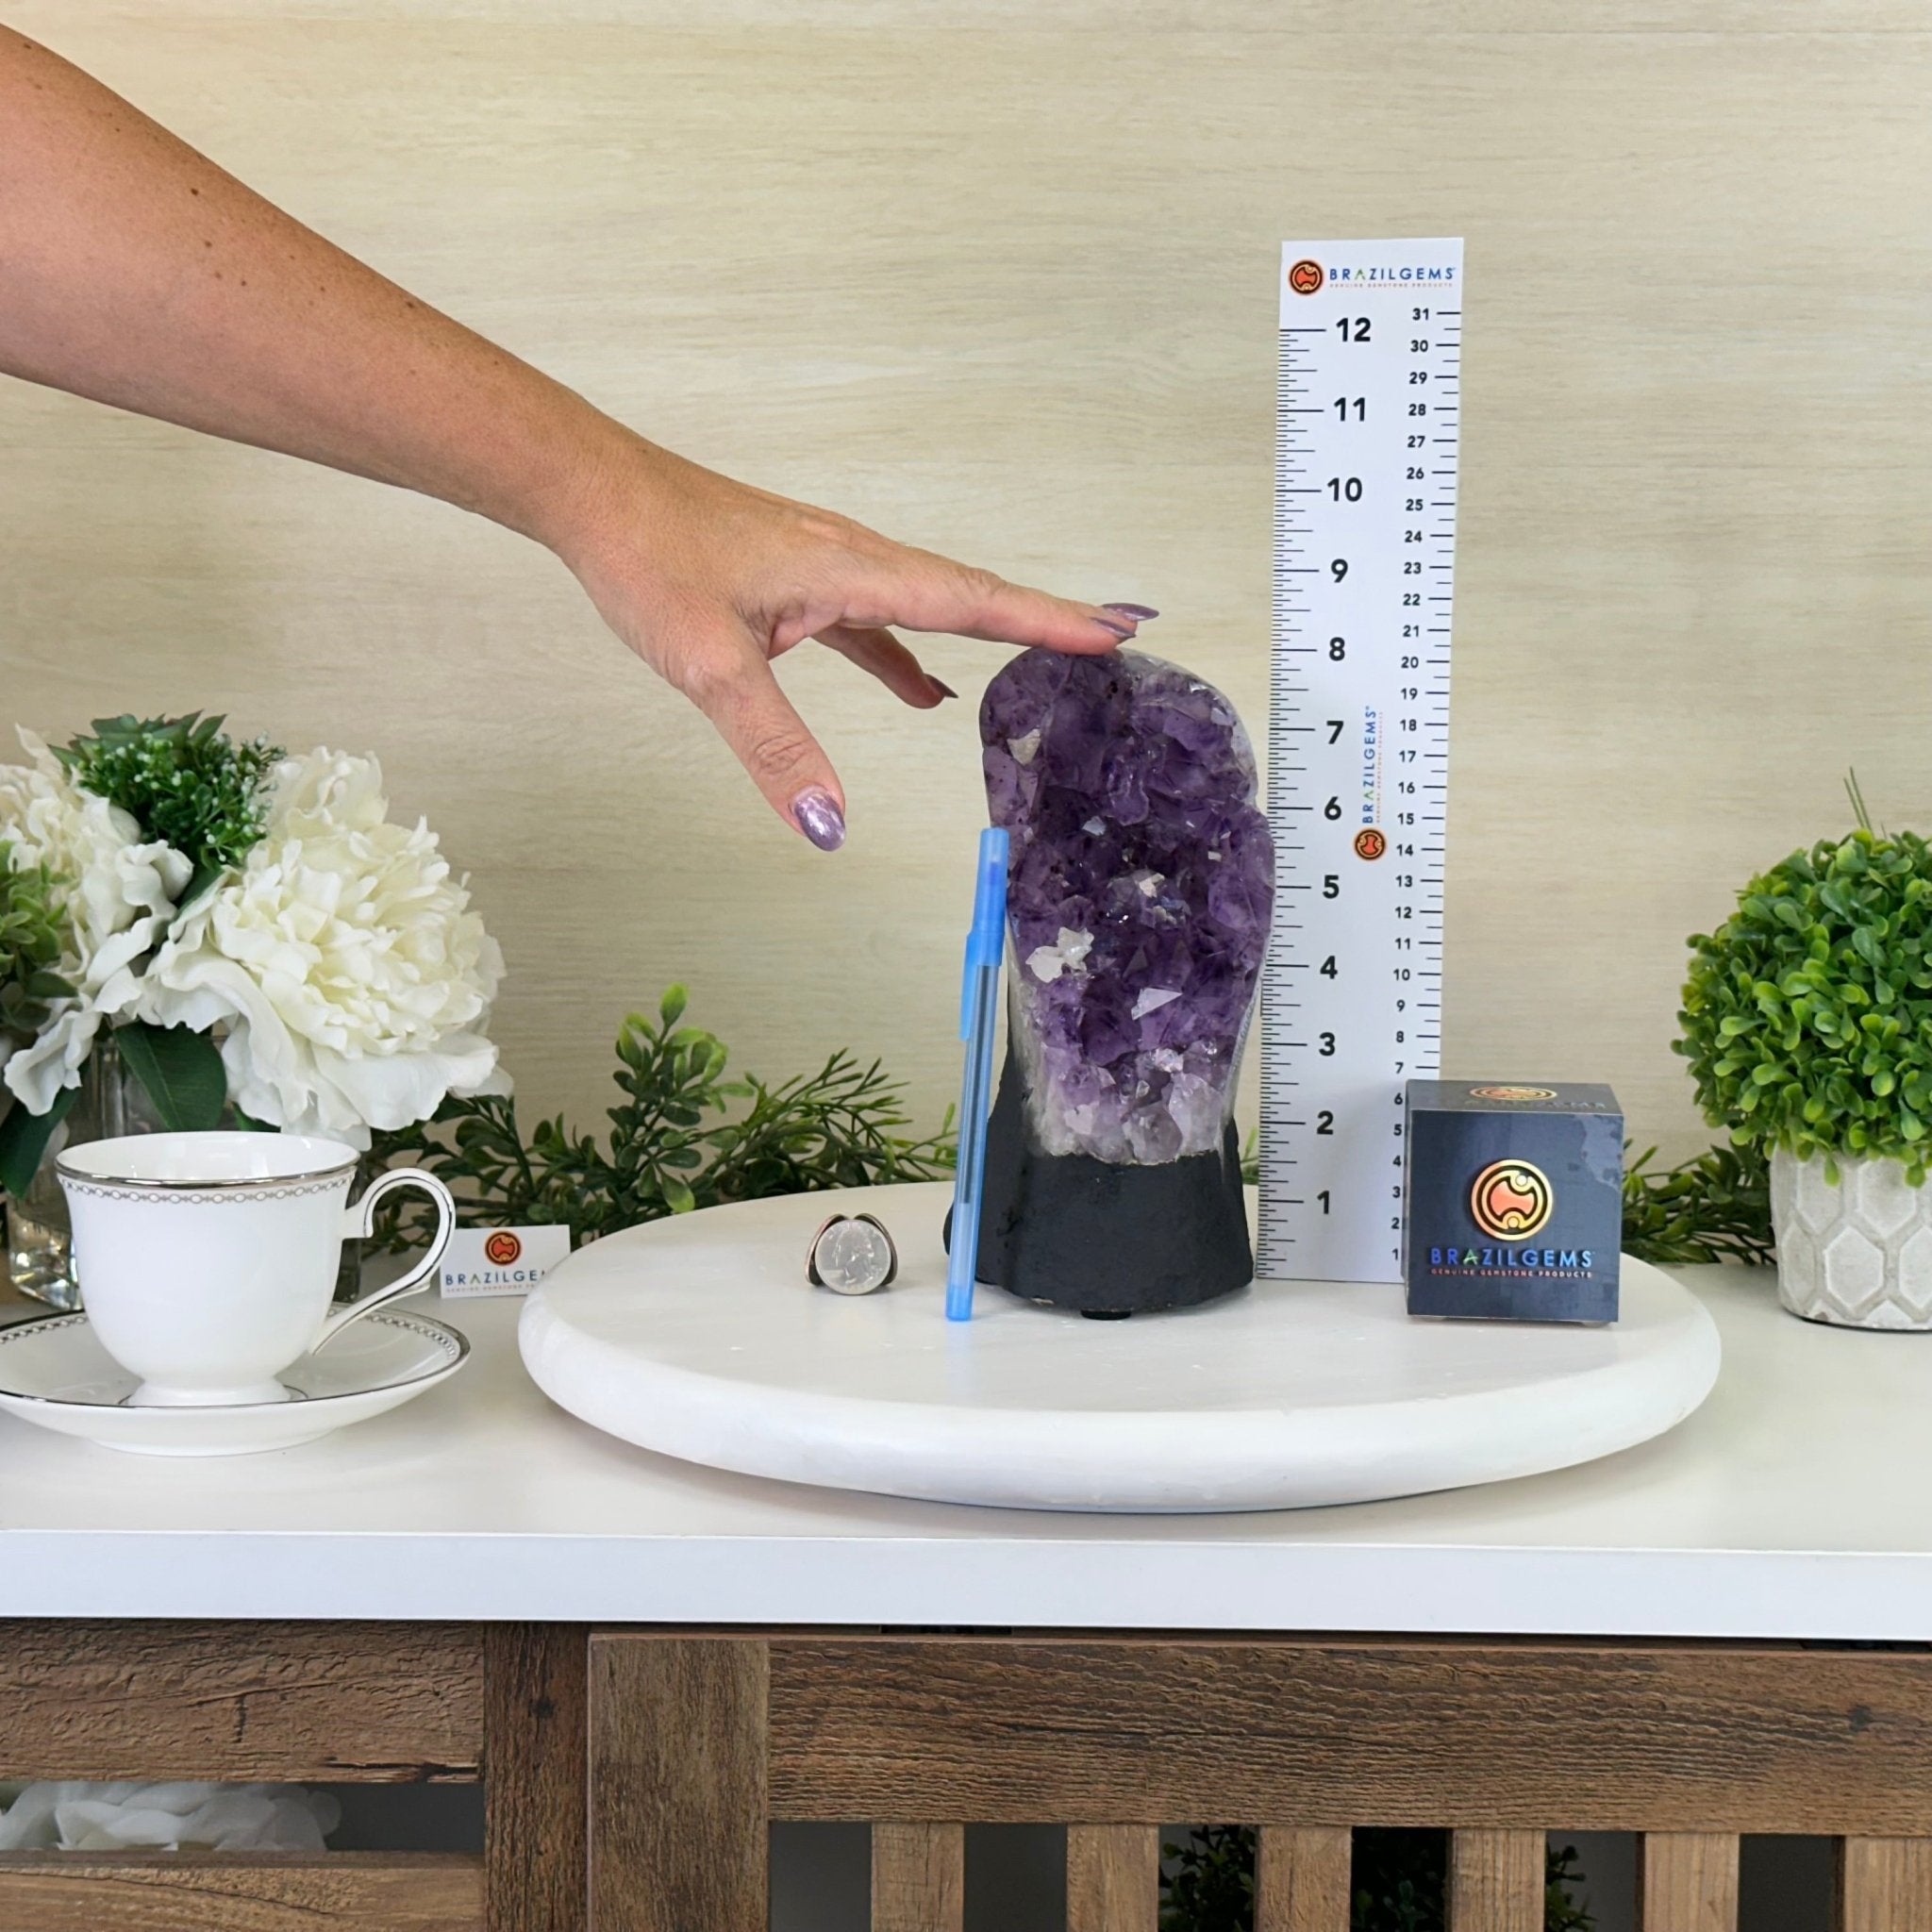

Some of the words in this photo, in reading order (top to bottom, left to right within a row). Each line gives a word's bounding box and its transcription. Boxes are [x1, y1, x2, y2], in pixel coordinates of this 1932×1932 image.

[1329, 267, 1454, 281] BRAZILGEMS
[1412, 308, 1429, 321] 31
[1336, 317, 1372, 342] 12
[1410, 339, 1429, 353] 30
[1408, 371, 1427, 385] 29
[1334, 397, 1366, 422] 11
[1408, 403, 1426, 417] 28
[1407, 435, 1425, 448] 27
[1406, 466, 1424, 480] 26
[1327, 476, 1363, 503] 10
[1406, 498, 1424, 511] 25
[1405, 529, 1423, 543] 24
[1330, 558, 1349, 583] 9
[1404, 561, 1422, 575] 23
[1403, 592, 1421, 607] 22
[1403, 625, 1420, 638] 21
[1328, 637, 1345, 662] 8
[1401, 656, 1419, 669] 20
[1401, 687, 1418, 700] 19
[1400, 718, 1417, 732] 18
[1326, 720, 1344, 745] 7
[1399, 750, 1417, 763] 17
[1362, 709, 1377, 824] BRAZILGEMS
[1398, 781, 1416, 794] 16
[1324, 795, 1342, 821] 6
[1397, 812, 1414, 825] 15
[1396, 843, 1414, 857] 14
[1322, 874, 1340, 899] 5
[1395, 874, 1413, 888] 13
[1394, 906, 1412, 919] 12
[1395, 937, 1411, 950] 11
[1320, 955, 1339, 980] 4
[1393, 968, 1410, 981] 10
[1396, 999, 1406, 1012] 9
[1395, 1030, 1405, 1043] 8
[1319, 1031, 1336, 1057] 3
[1395, 1061, 1404, 1074] 7
[1393, 1092, 1404, 1106] 6
[1316, 1110, 1334, 1136] 2
[1393, 1124, 1403, 1137] 5
[1392, 1155, 1402, 1167] 4
[1392, 1185, 1401, 1199] 3
[1317, 1190, 1330, 1215] 1
[1391, 1217, 1400, 1230] 2
[1391, 1248, 1399, 1260] 1
[1430, 1247, 1593, 1268] BRAZILGEMS
[445, 1270, 545, 1286] BRAZILGE
[1430, 1268, 1475, 1276] GENUINE
[1480, 1269, 1534, 1277] GEMSTONE
[1538, 1270, 1593, 1279] PRODUCTS
